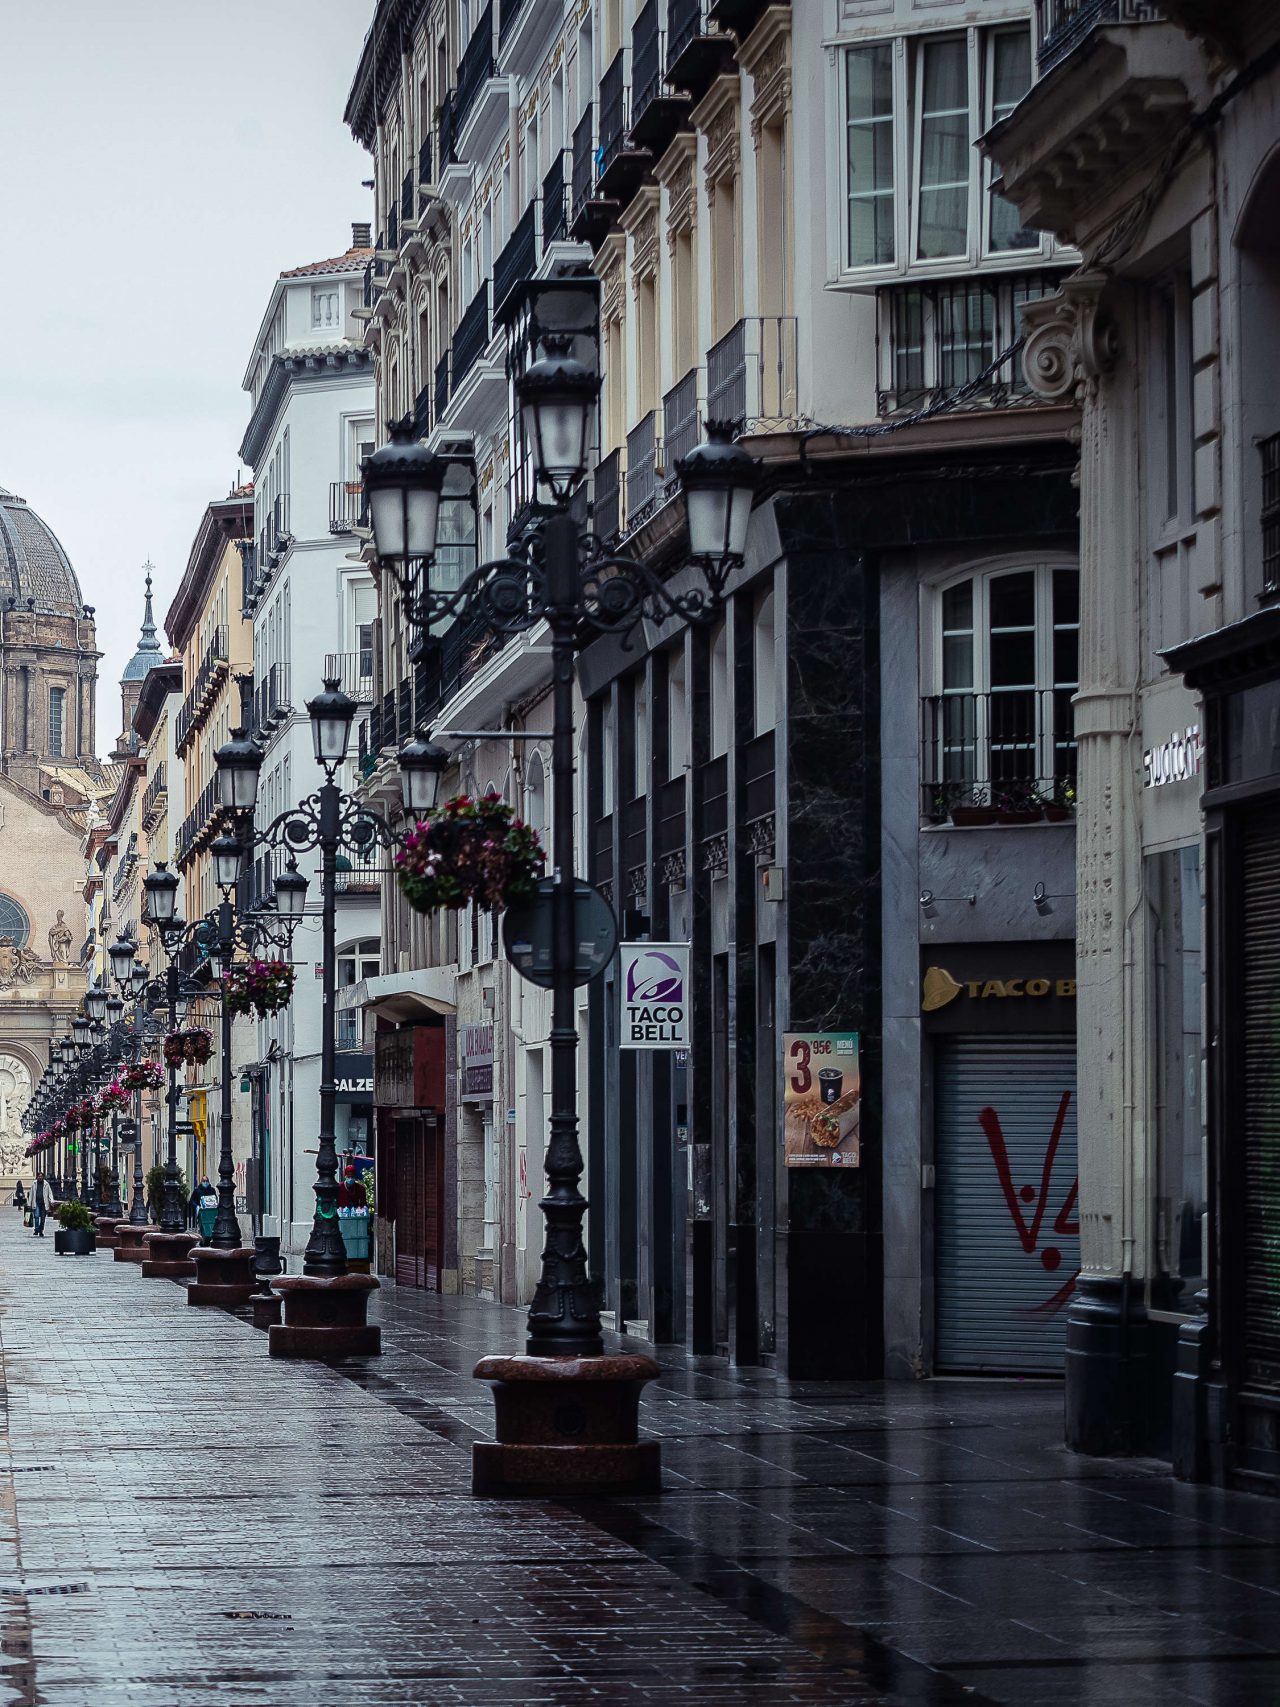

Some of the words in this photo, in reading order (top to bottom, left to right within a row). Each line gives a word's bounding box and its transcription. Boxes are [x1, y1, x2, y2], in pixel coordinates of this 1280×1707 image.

[964, 979, 1051, 999] TACO
[627, 1006, 683, 1024] TACO
[631, 1024, 683, 1041] BELL
[836, 1039, 853, 1049] MENÚ
